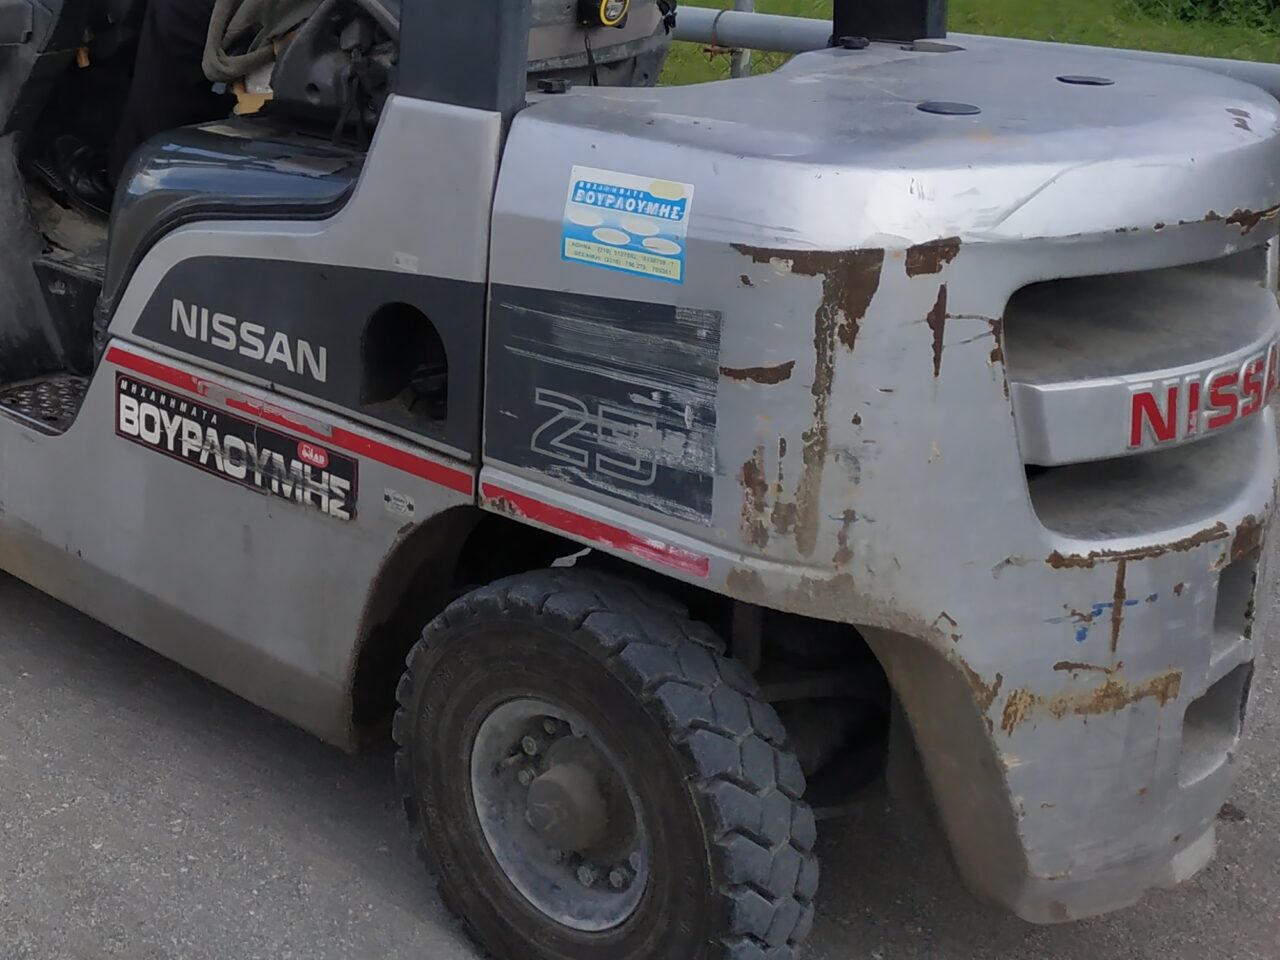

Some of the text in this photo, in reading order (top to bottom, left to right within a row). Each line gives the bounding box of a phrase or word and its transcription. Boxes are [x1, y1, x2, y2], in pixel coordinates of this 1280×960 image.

[575, 189, 682, 221] ΒΟΥΡΛΟΥΜΗΣ
[171, 298, 327, 383] NISSAN
[120, 379, 218, 425] ΜΗΧΑΝΗΜΑΤΑ
[531, 386, 658, 486] 25
